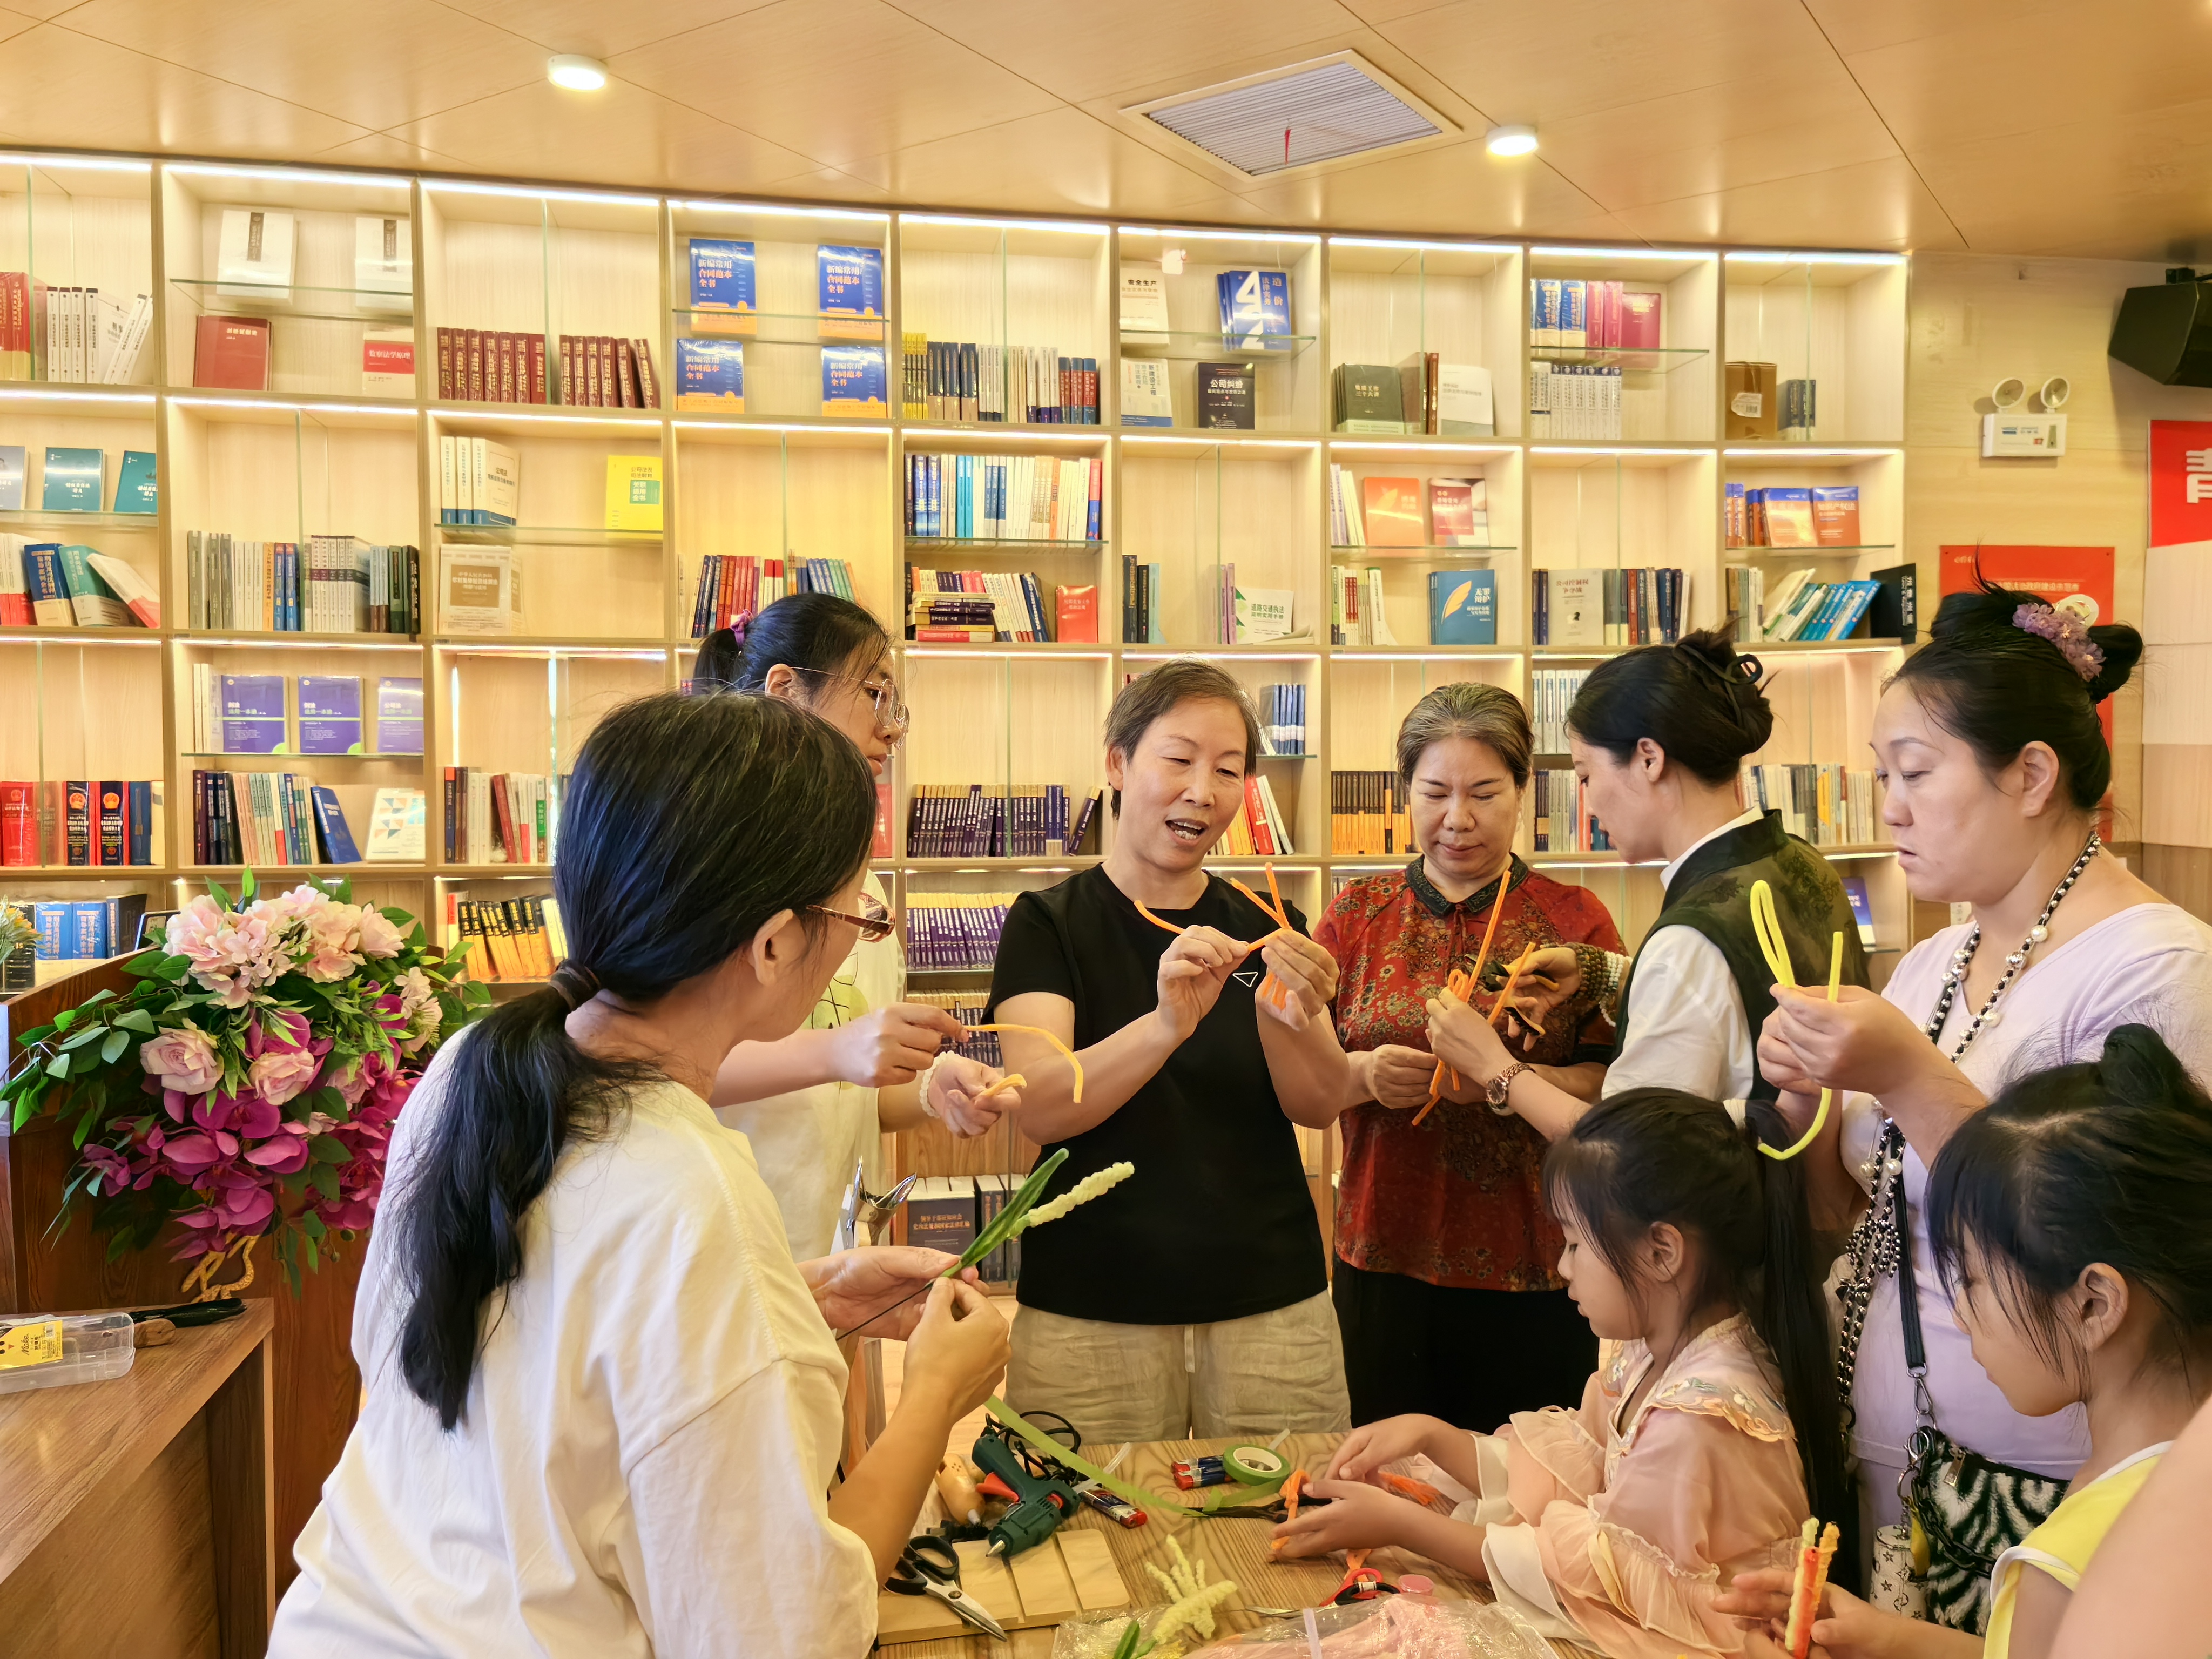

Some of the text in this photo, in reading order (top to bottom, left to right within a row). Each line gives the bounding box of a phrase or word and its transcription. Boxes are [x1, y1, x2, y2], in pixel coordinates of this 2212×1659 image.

[1210, 379, 1243, 388] 公司纠纷
[1251, 604, 1284, 613] 道路交通执法
